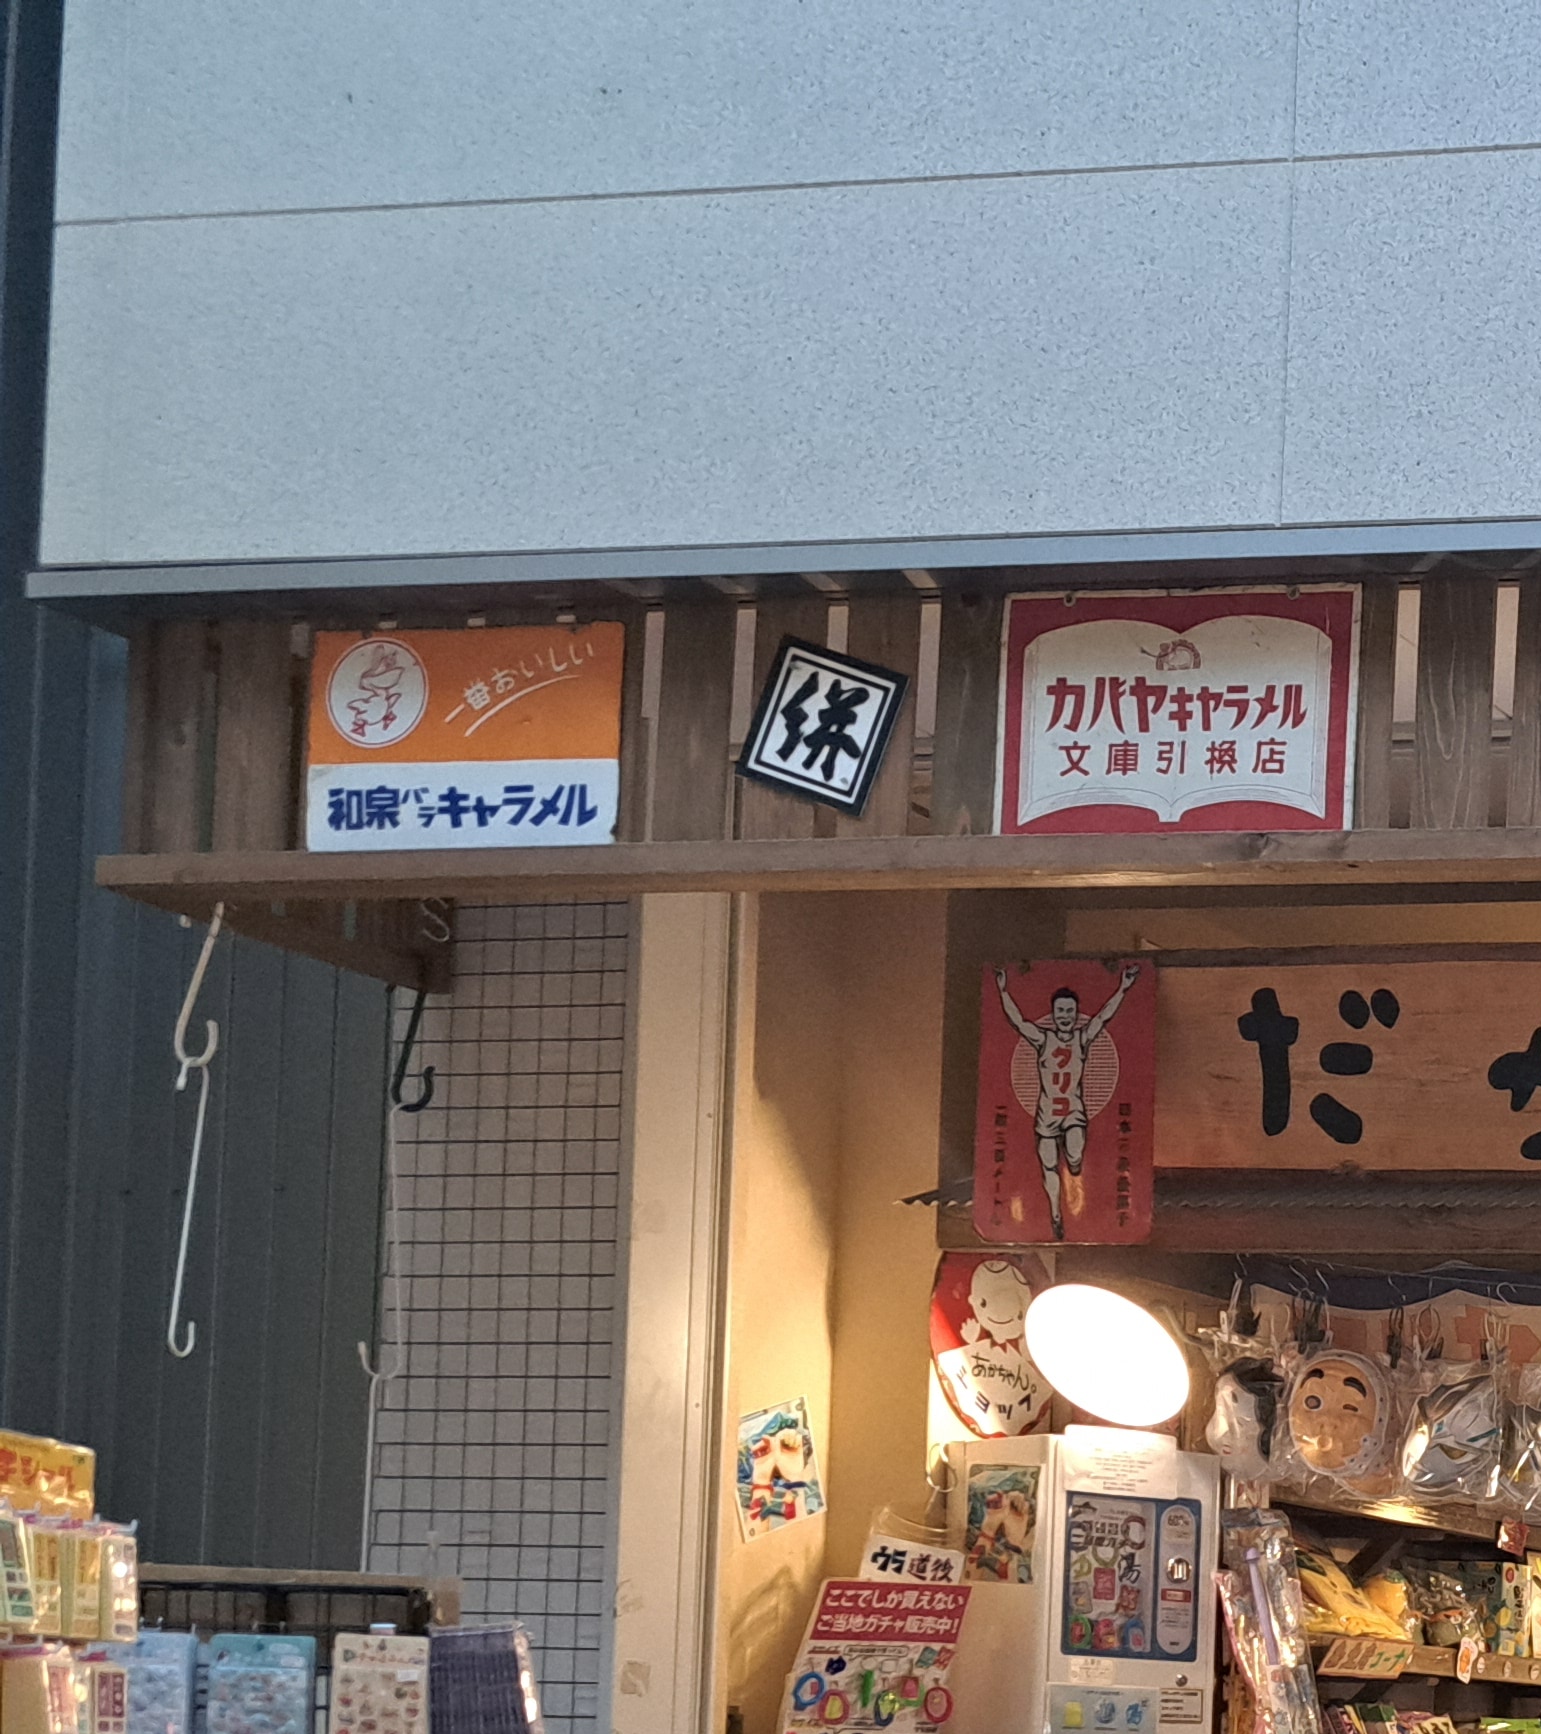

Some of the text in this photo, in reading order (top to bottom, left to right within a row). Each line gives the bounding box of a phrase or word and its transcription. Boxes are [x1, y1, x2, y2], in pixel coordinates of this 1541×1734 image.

[444, 642, 595, 724] 一番おいしい
[1045, 676, 1308, 734] カバヤキャラメル
[1058, 738, 1288, 777] 文庫引換店
[1051, 1043, 1072, 1117] グリコ
[825, 1588, 964, 1610] ここでしか買えない
